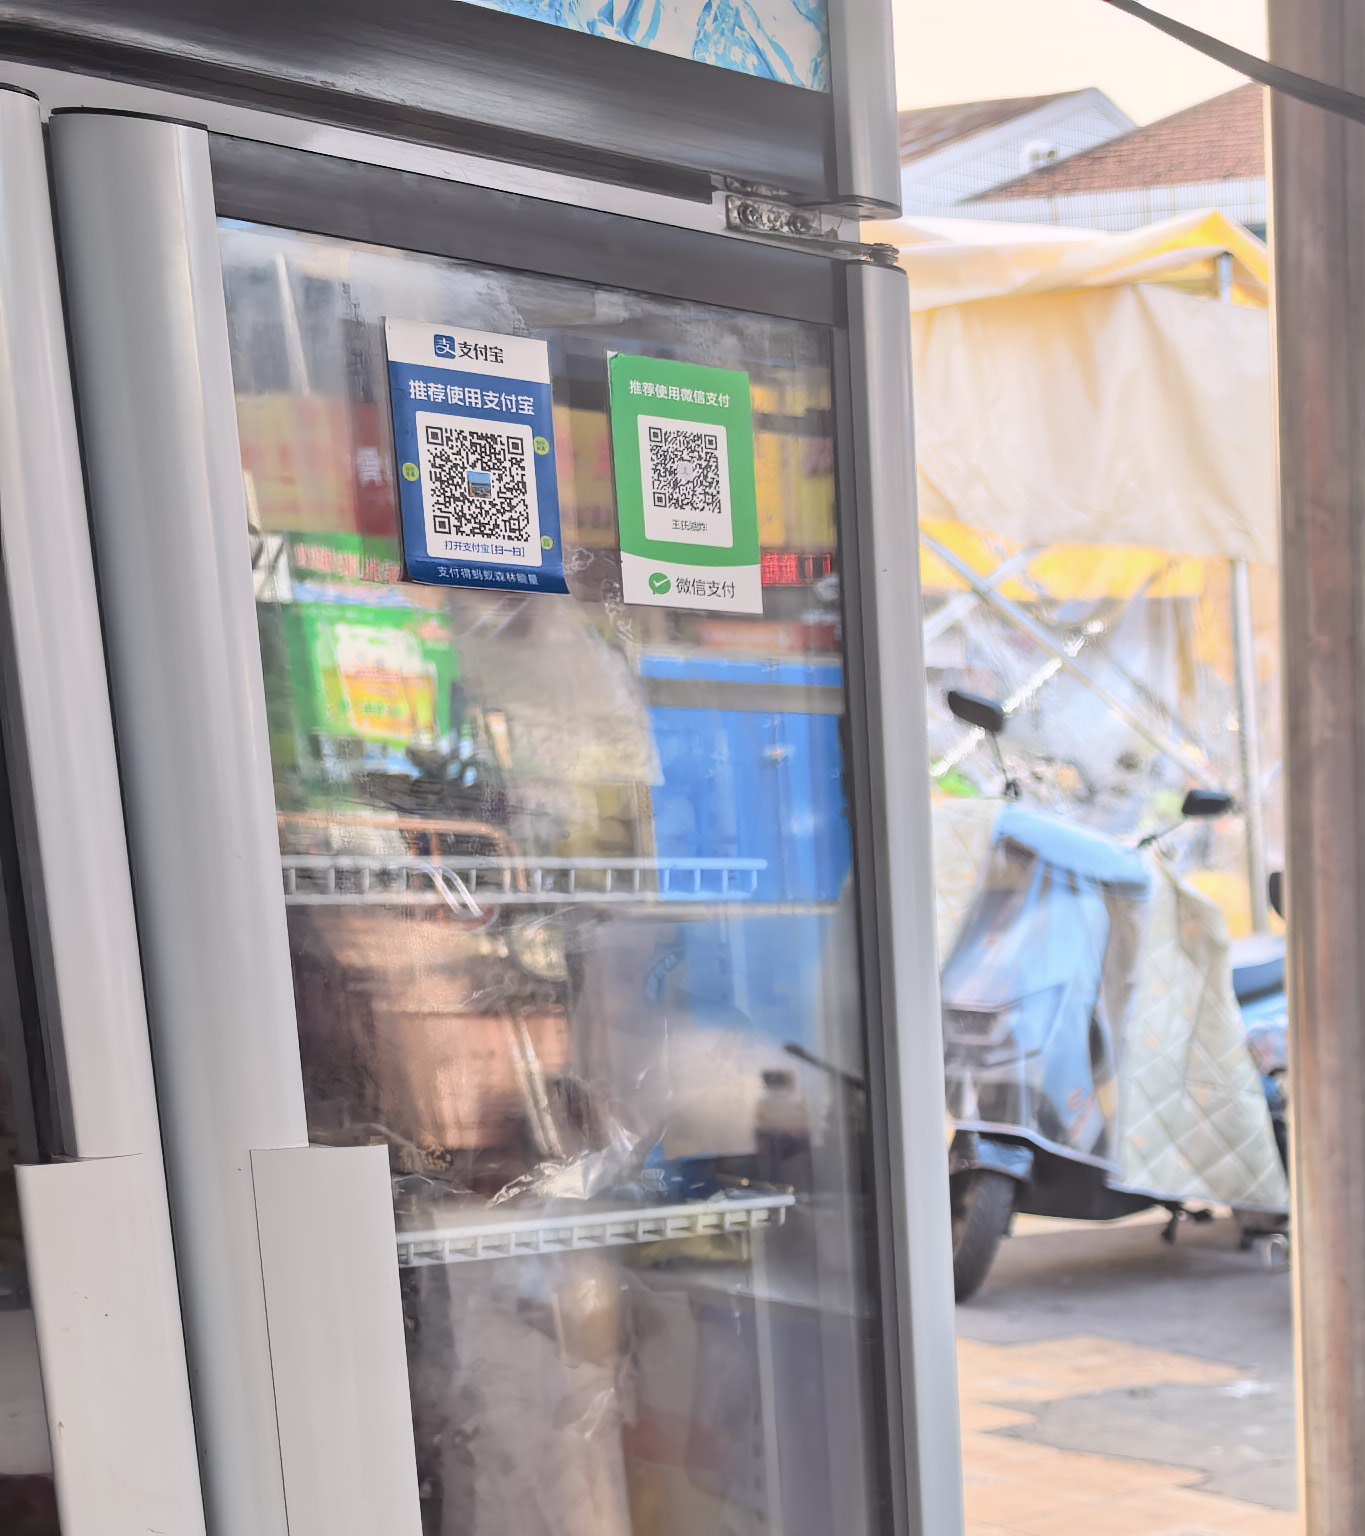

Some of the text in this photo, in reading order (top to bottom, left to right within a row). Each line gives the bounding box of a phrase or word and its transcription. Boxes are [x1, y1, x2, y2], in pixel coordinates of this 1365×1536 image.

[457, 341, 504, 364] 支付宝
[408, 379, 535, 416] 推荐使用支付宝
[629, 379, 731, 408] 推荐使用微信支付
[676, 577, 735, 599] 微信支付
